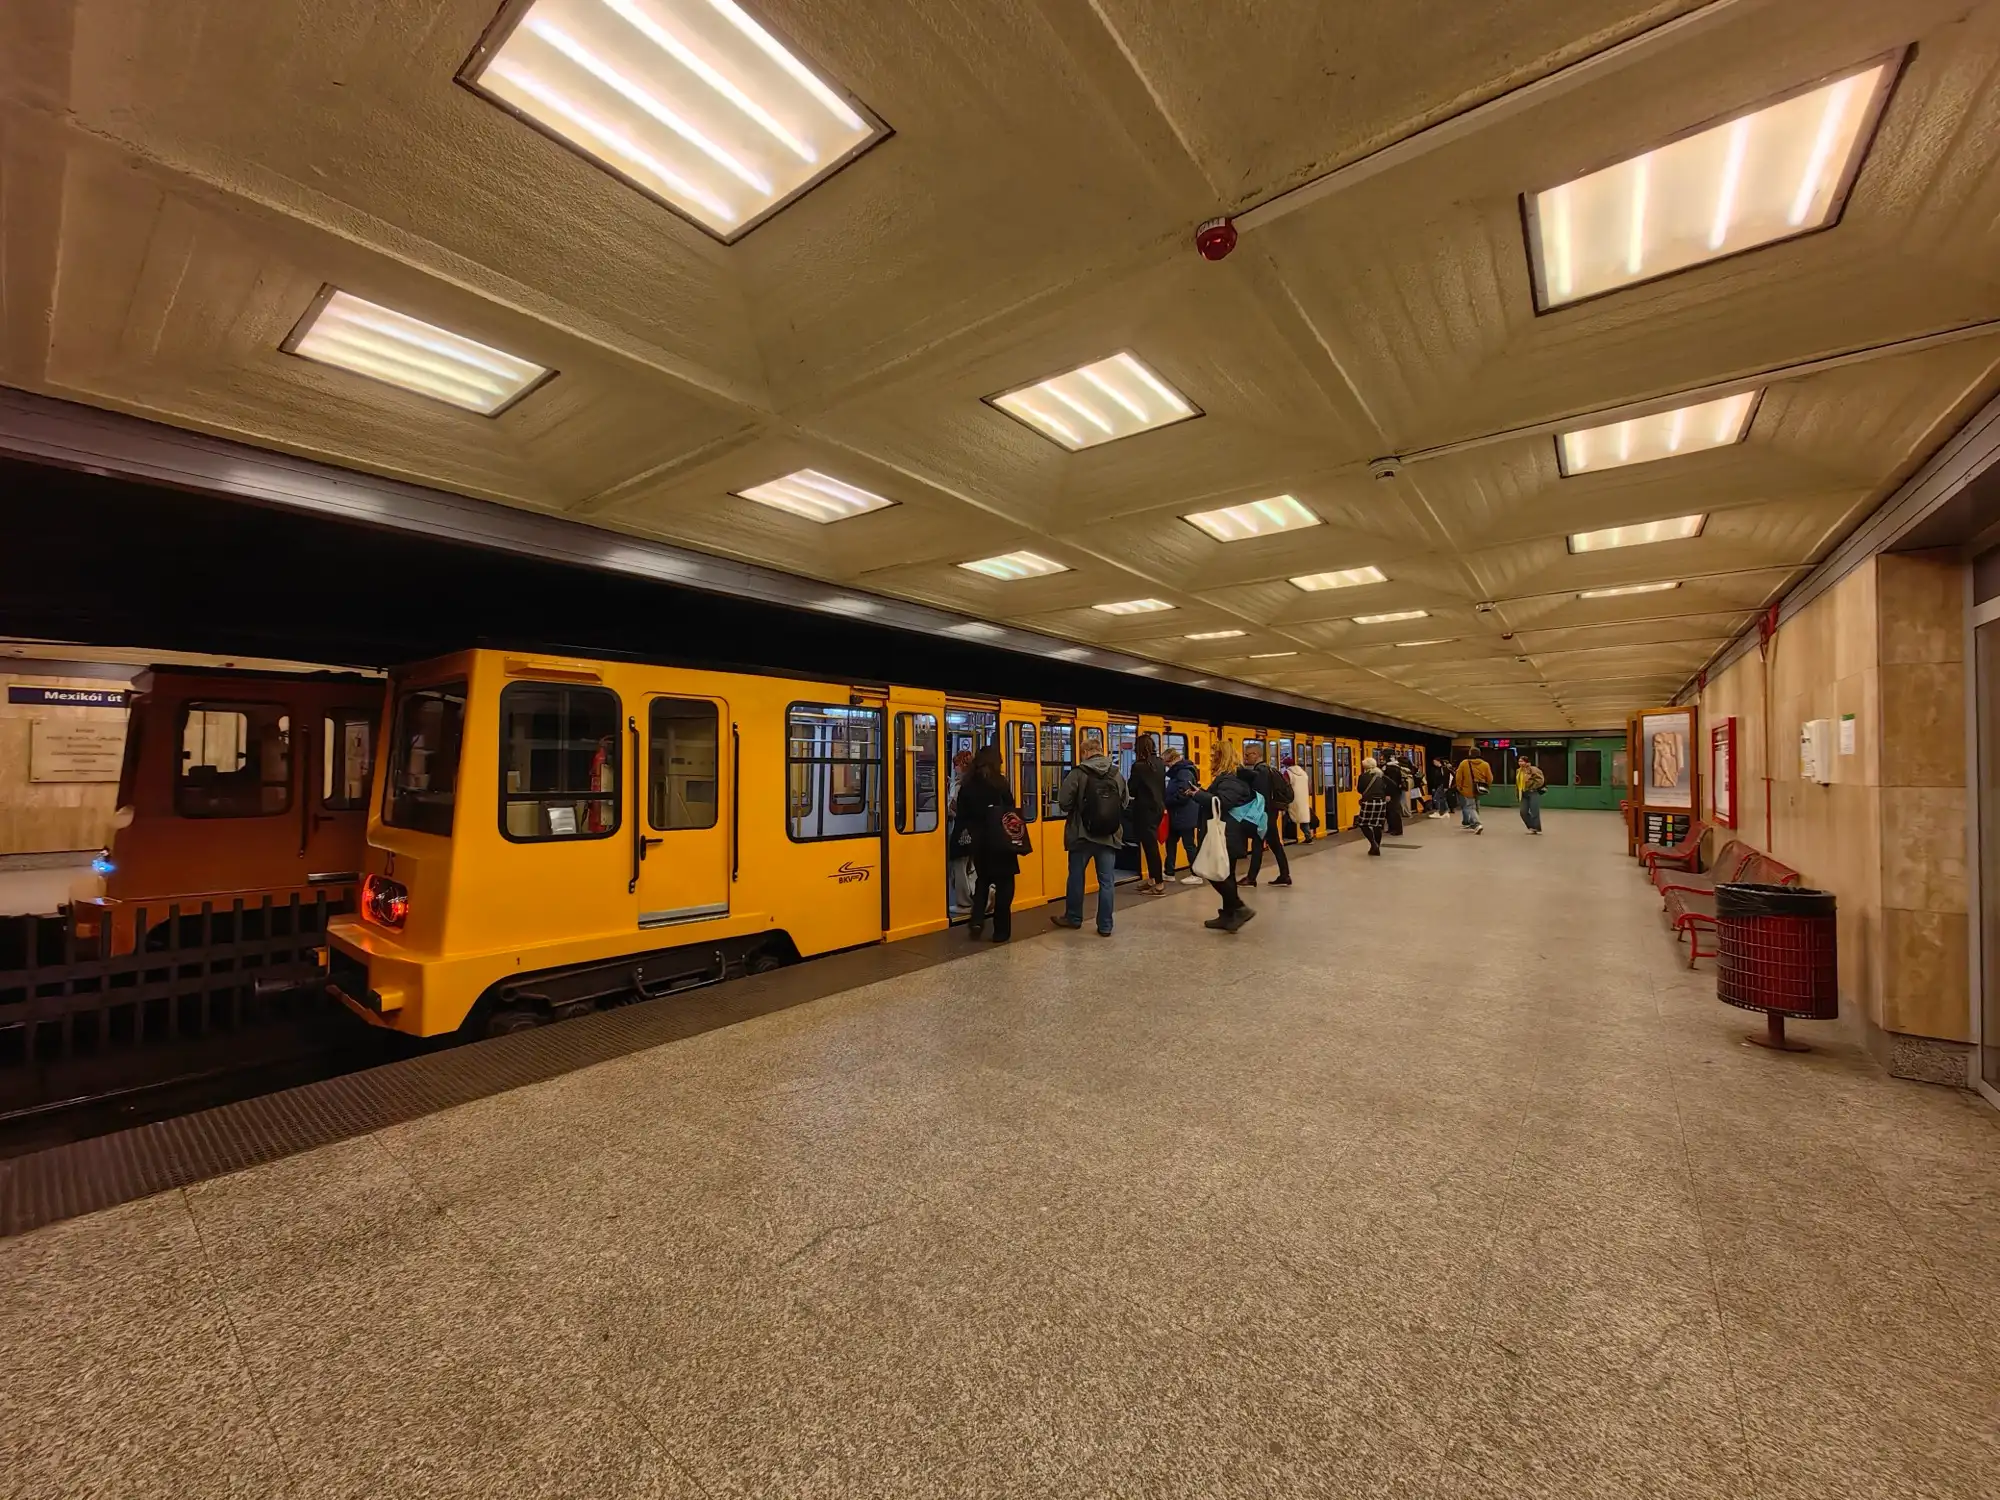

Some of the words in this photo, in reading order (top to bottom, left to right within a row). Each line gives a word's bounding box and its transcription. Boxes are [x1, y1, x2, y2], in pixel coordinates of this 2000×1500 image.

[44, 691, 102, 701] Mexikói
[107, 694, 122, 702] út
[839, 876, 853, 884] BKV
